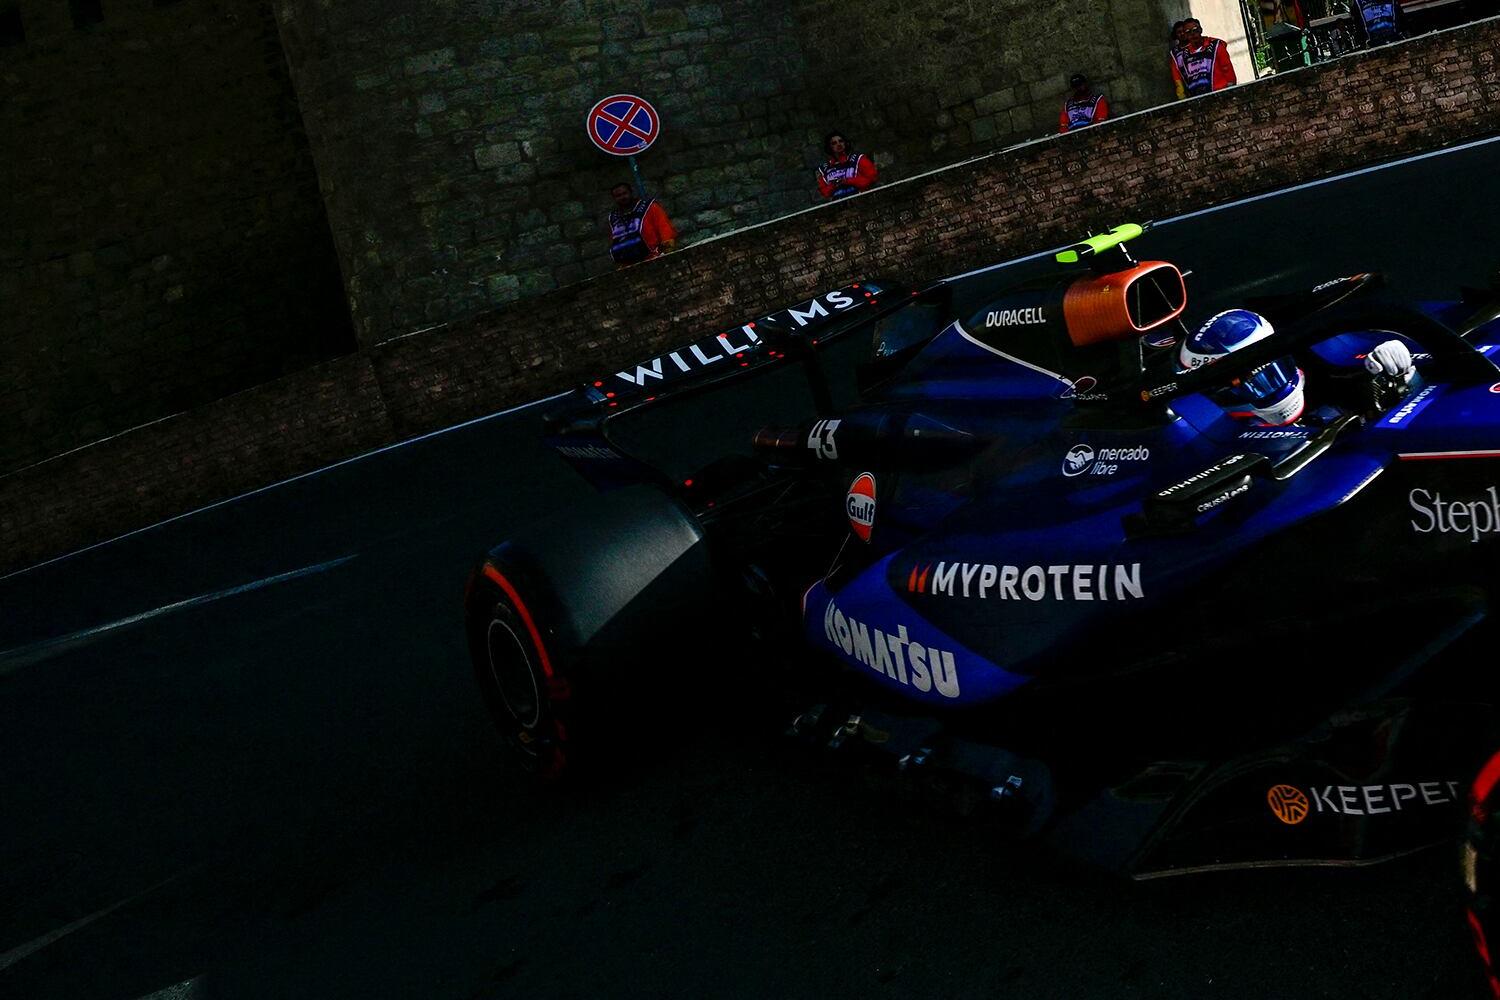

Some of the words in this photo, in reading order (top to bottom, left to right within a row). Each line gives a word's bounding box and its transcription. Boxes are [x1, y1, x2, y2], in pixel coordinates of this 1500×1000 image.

[985, 306, 1047, 329] DURACELL
[615, 290, 854, 387] WILLIMS
[807, 419, 842, 460] 43
[1097, 444, 1150, 461] mercado
[1089, 461, 1119, 475] libre
[848, 496, 874, 524] Gulf
[931, 561, 1145, 601] MYPROTEIN
[824, 598, 961, 699] KOMATSU
